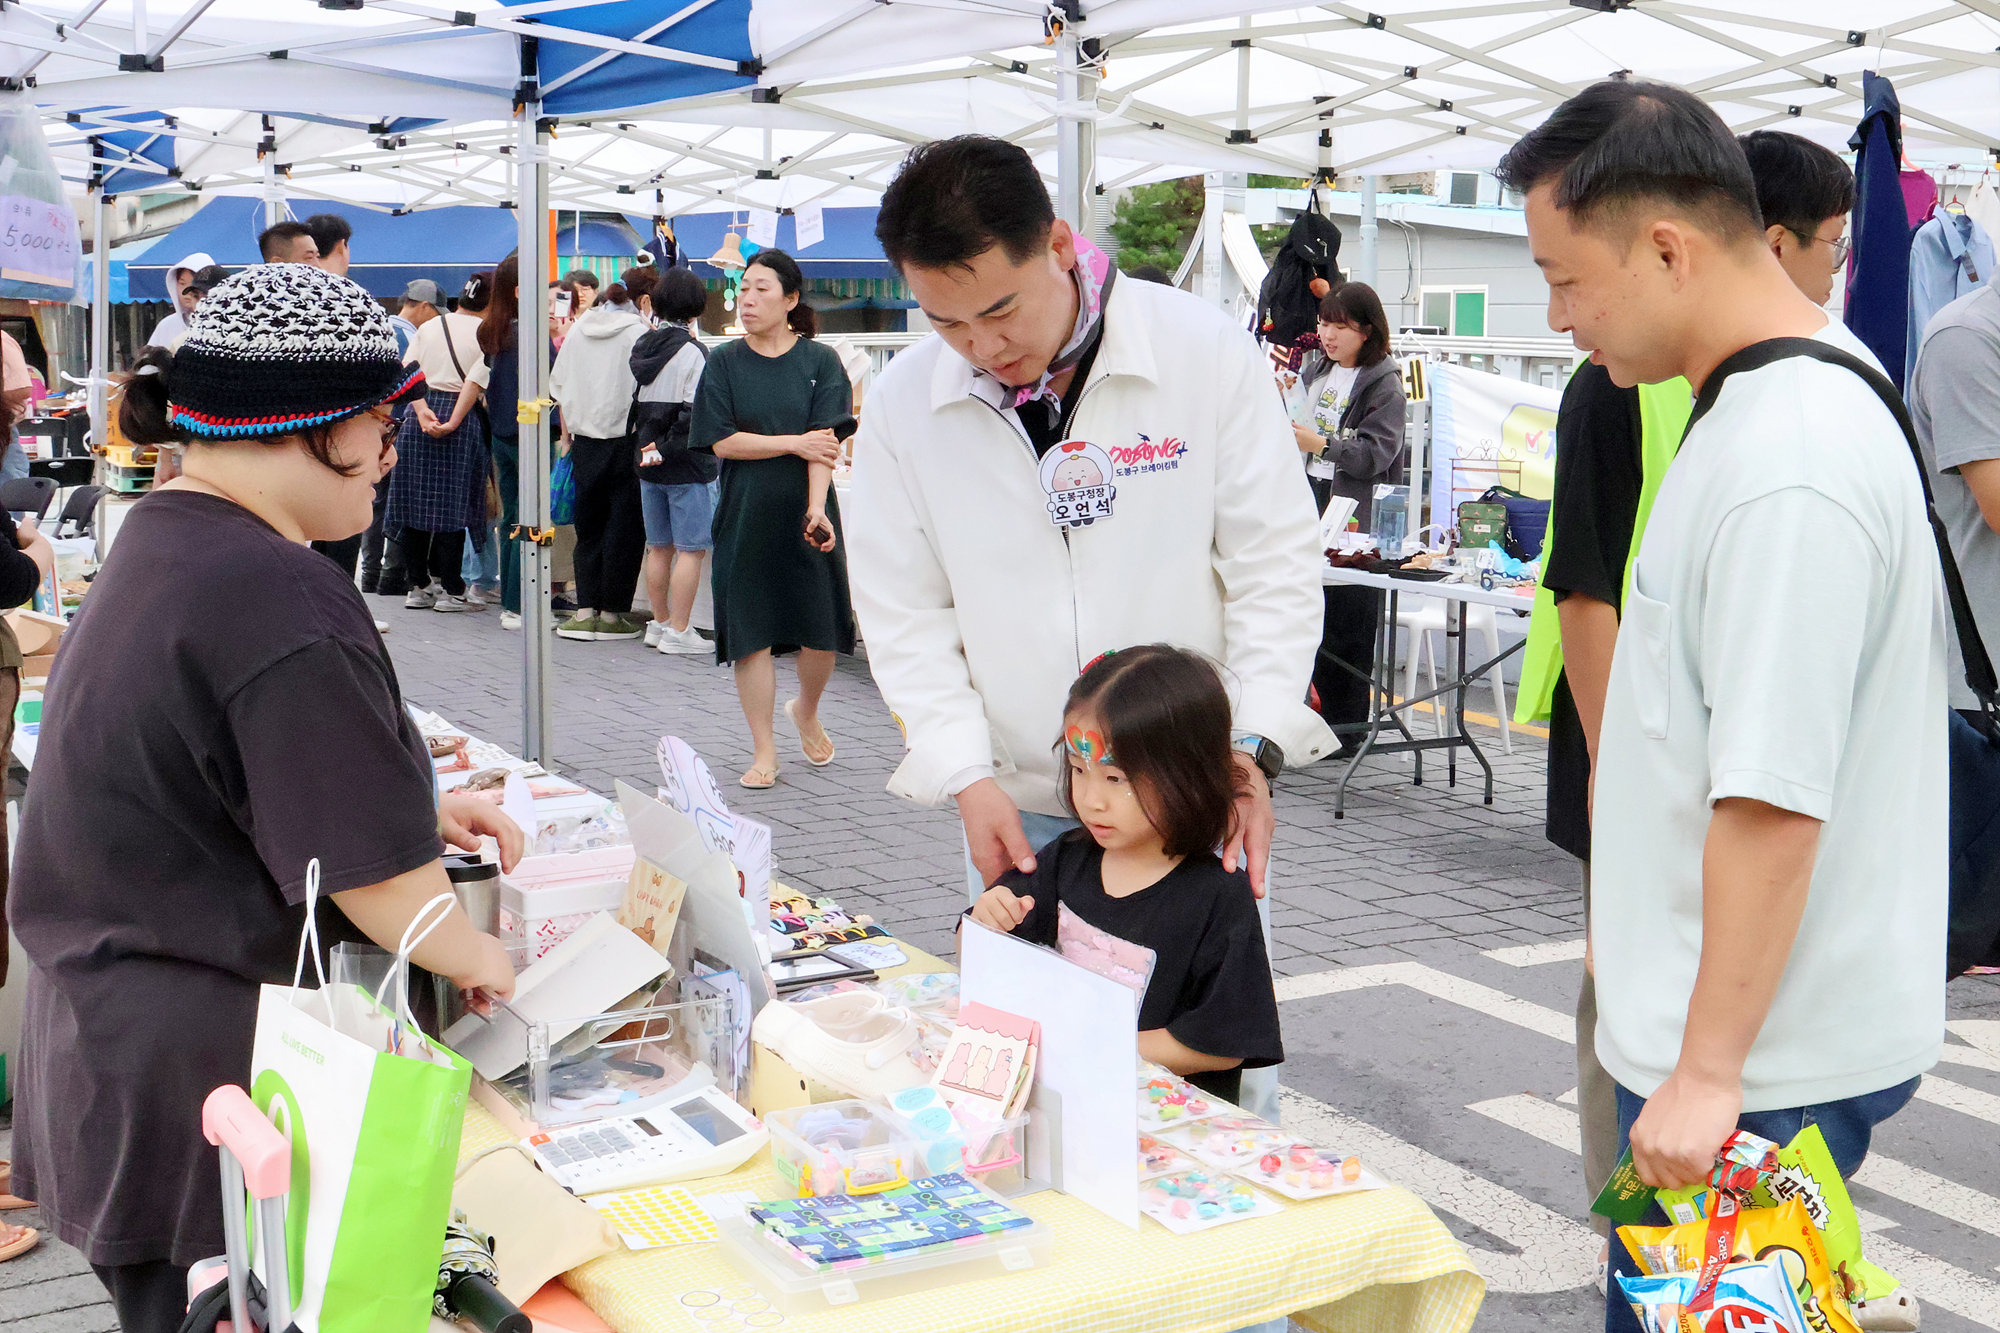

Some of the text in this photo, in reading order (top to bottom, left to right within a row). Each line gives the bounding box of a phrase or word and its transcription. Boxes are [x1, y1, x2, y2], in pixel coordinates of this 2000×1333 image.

[1115, 466, 1139, 477] 도봉구
[1057, 487, 1105, 503] 도봉구청장
[301, 1044, 325, 1067] BETTER
[1717, 1235, 1728, 1262] 오리온
[1805, 1237, 1821, 1267] 오리온
